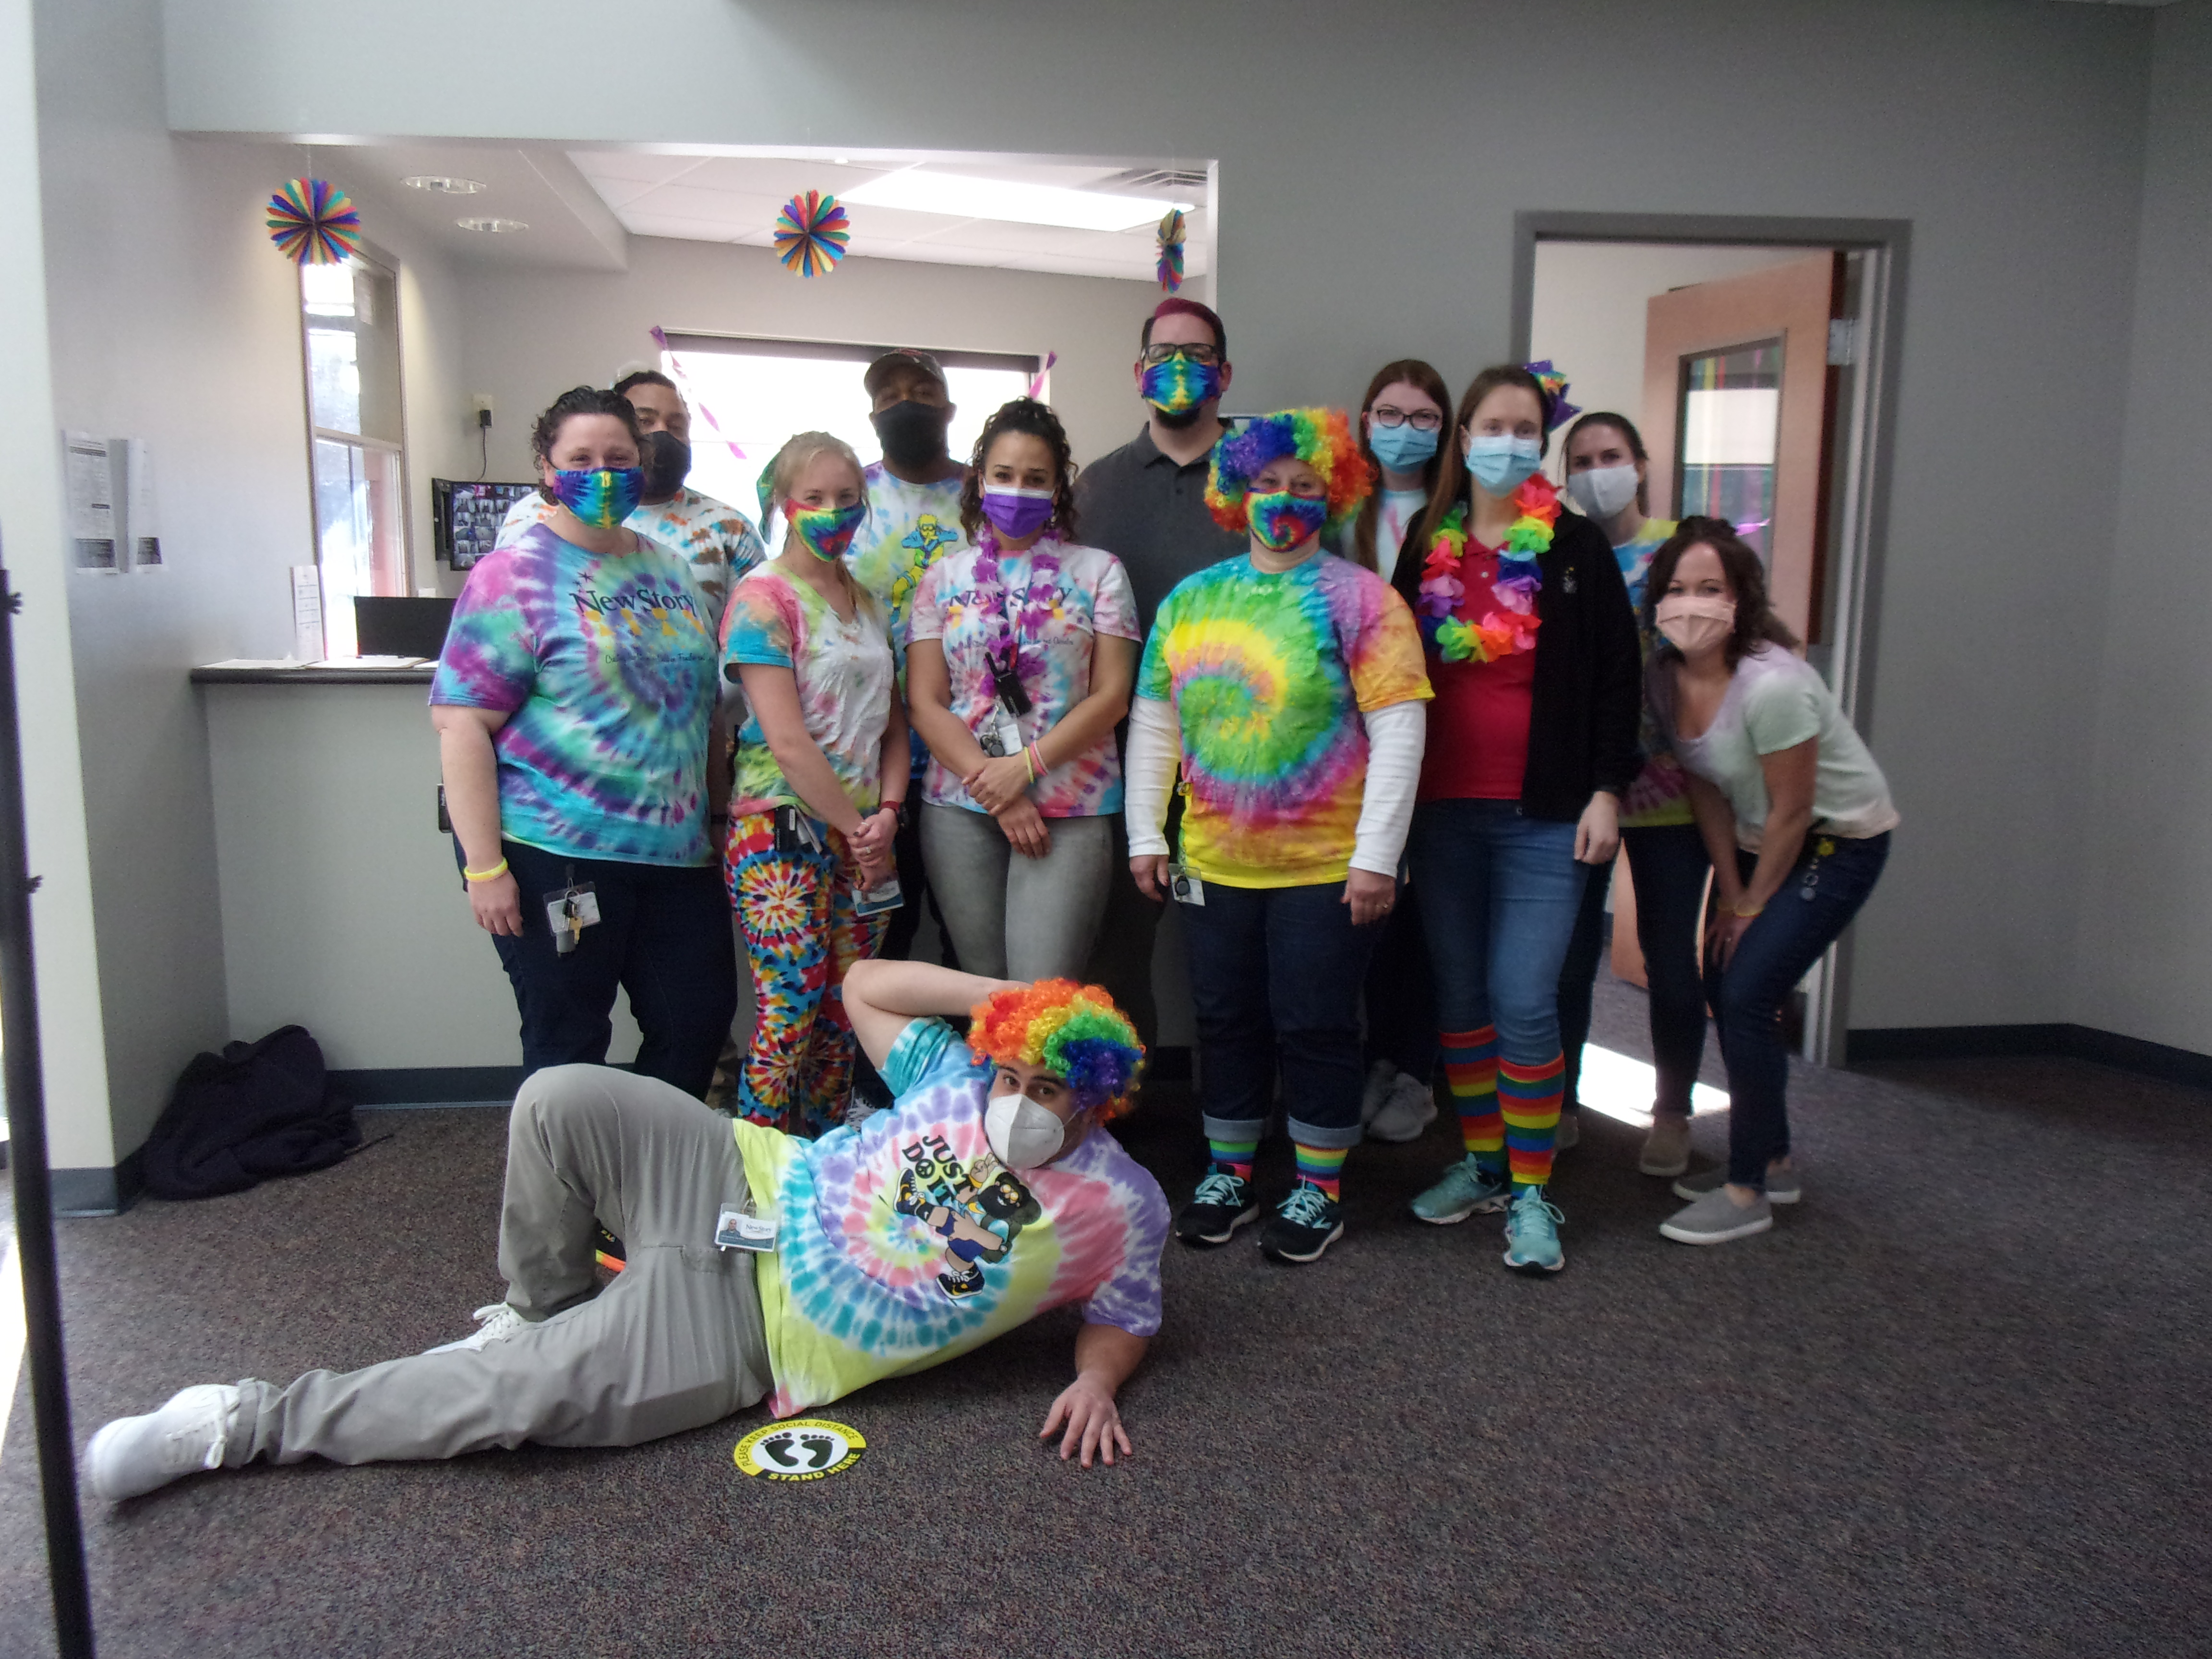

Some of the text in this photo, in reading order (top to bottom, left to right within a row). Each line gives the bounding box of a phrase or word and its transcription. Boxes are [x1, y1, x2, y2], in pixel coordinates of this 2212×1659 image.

[902, 1141, 936, 1179] DO
[922, 1134, 978, 1193] JUST
[927, 1175, 956, 1205] IT
[738, 1421, 859, 1467] PLEASE KEEP SOCIAL DISTANCE
[768, 1453, 861, 1481] STAND HERE
